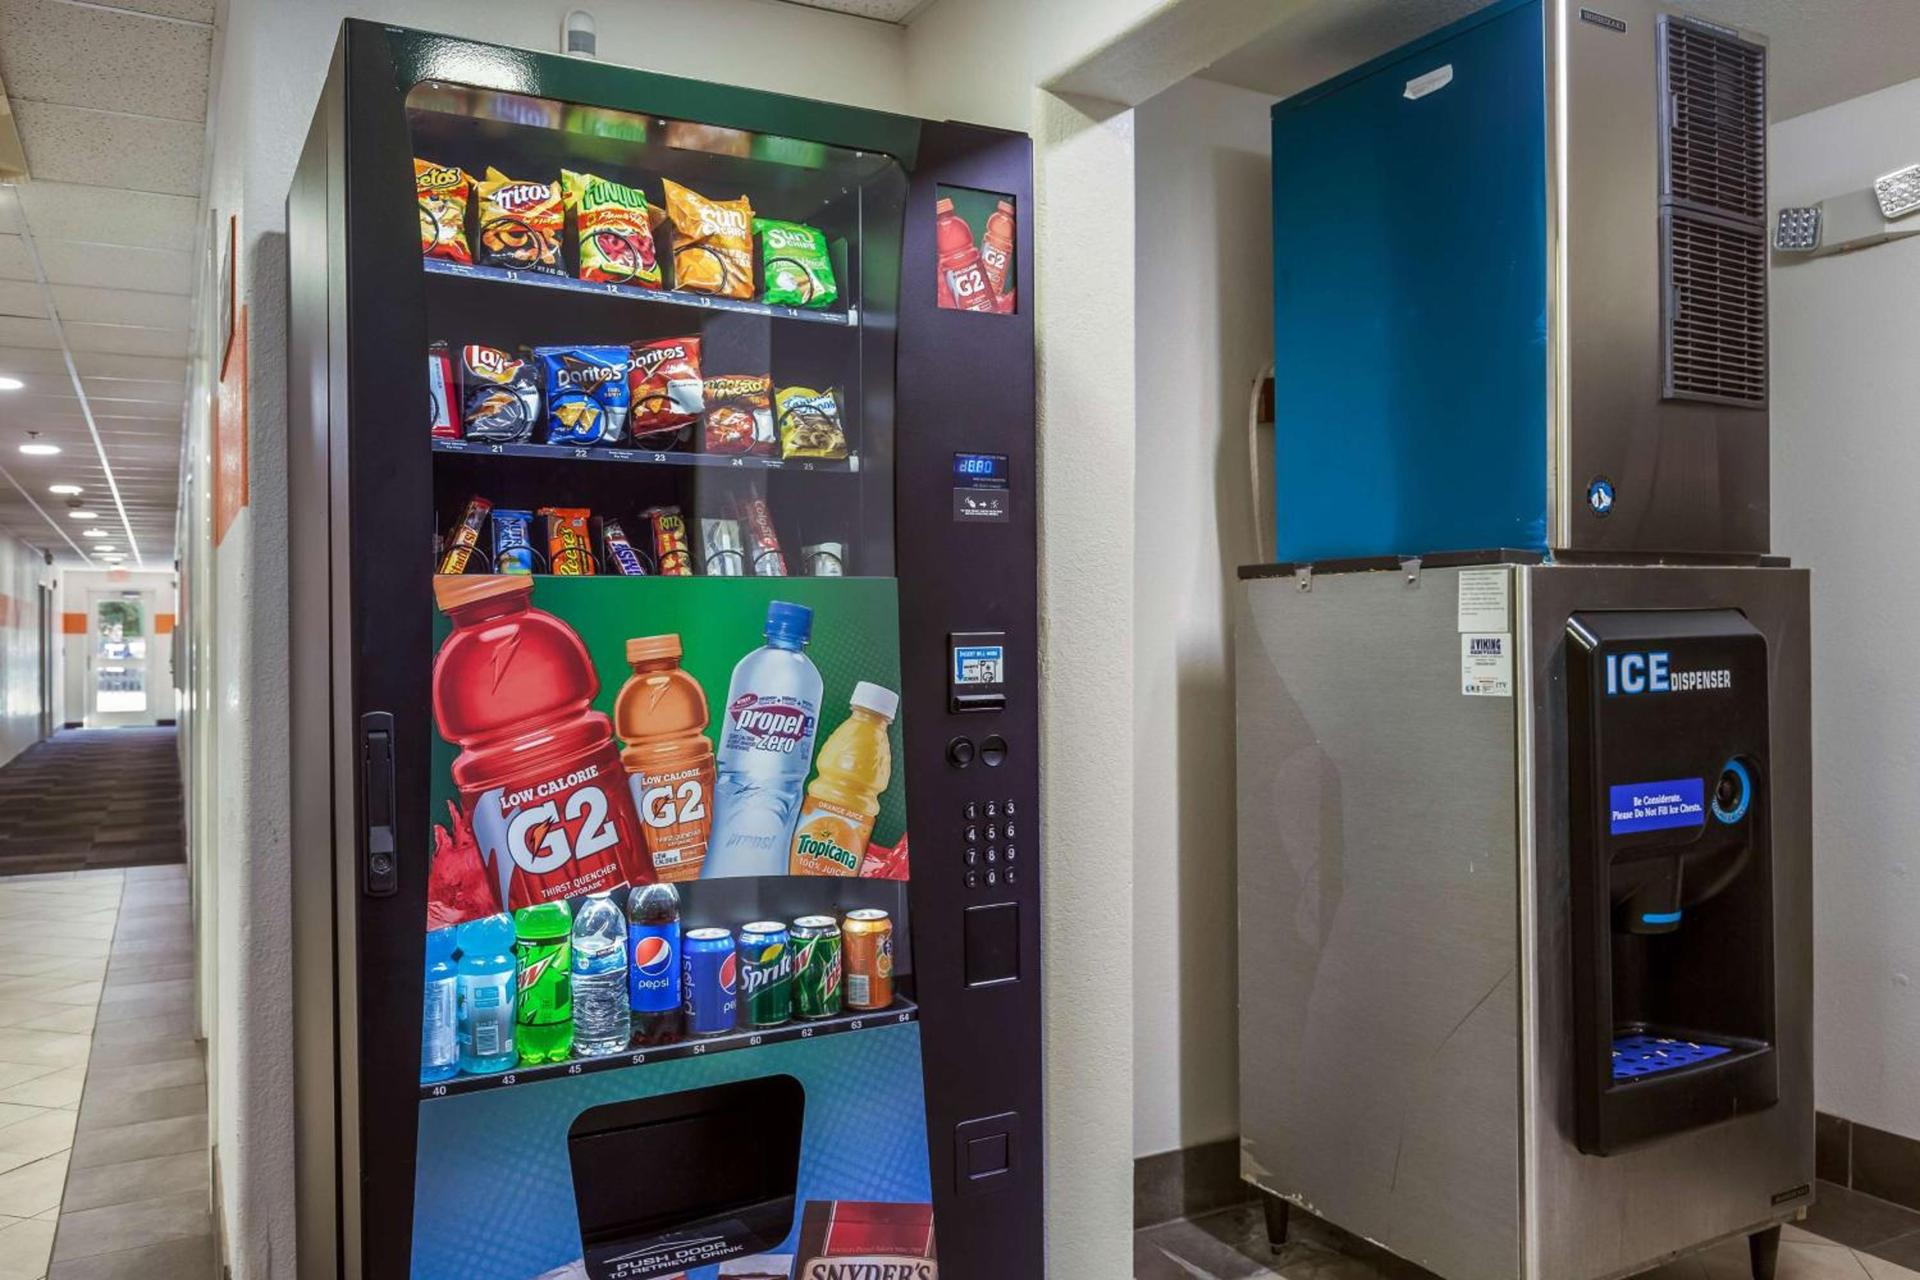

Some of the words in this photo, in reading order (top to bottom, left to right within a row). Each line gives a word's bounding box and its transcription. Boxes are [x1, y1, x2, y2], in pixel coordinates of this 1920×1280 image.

[984, 250, 1006, 270] G2
[507, 271, 518, 280] 11
[607, 284, 618, 294] 12
[955, 270, 985, 296] G2
[701, 298, 711, 306] 13
[788, 309, 798, 317] 14
[557, 365, 622, 387] Doritos
[492, 445, 503, 454] 21
[575, 450, 587, 458] 22
[654, 454, 666, 462] 23
[804, 463, 814, 471] 25
[1606, 652, 1670, 695] ICE
[1670, 670, 1732, 692] DISPENSER
[735, 710, 805, 736] propel
[755, 734, 796, 753] zero
[500, 788, 534, 809] LOW
[536, 765, 599, 798] CALORIE
[642, 776, 662, 786] LOW
[642, 780, 705, 828] G2
[969, 805, 975, 817] 1
[988, 804, 996, 815] 2
[1007, 802, 1015, 814] 3
[818, 801, 846, 815] ORANGE
[846, 811, 865, 821] JUICE
[1612, 810, 1634, 821] Please
[1634, 809, 1644, 818] Do
[1658, 805, 1669, 815] Fill
[507, 786, 619, 875] G2
[968, 829, 975, 841] 4
[988, 827, 995, 839] 5
[1007, 825, 1015, 837] 6
[797, 834, 858, 870] Tropicana
[969, 852, 975, 863] 7
[988, 849, 995, 861] 8
[1007, 847, 1015, 859] 9
[799, 857, 821, 871] 100%
[821, 865, 848, 877] JUICE
[540, 881, 571, 899] THIRST
[572, 863, 617, 891] QUENCHER
[988, 872, 995, 883] 0
[638, 978, 670, 989] pepsi
[684, 954, 696, 1017] pepsi
[899, 1013, 910, 1022] 64
[851, 1020, 863, 1029] 63
[801, 1028, 813, 1038] 62
[750, 1036, 762, 1045] 60
[693, 1045, 705, 1054] 54
[632, 1055, 645, 1064] 50
[568, 1065, 582, 1074] 45
[502, 1075, 516, 1085] 43
[433, 1086, 447, 1096] 40
[608, 1271, 628, 1280] TO
[631, 1256, 697, 1275] RETRIEVE
[701, 1244, 745, 1260] DRINK
[616, 1254, 669, 1271] PUSH
[675, 1241, 727, 1260] DOOR
